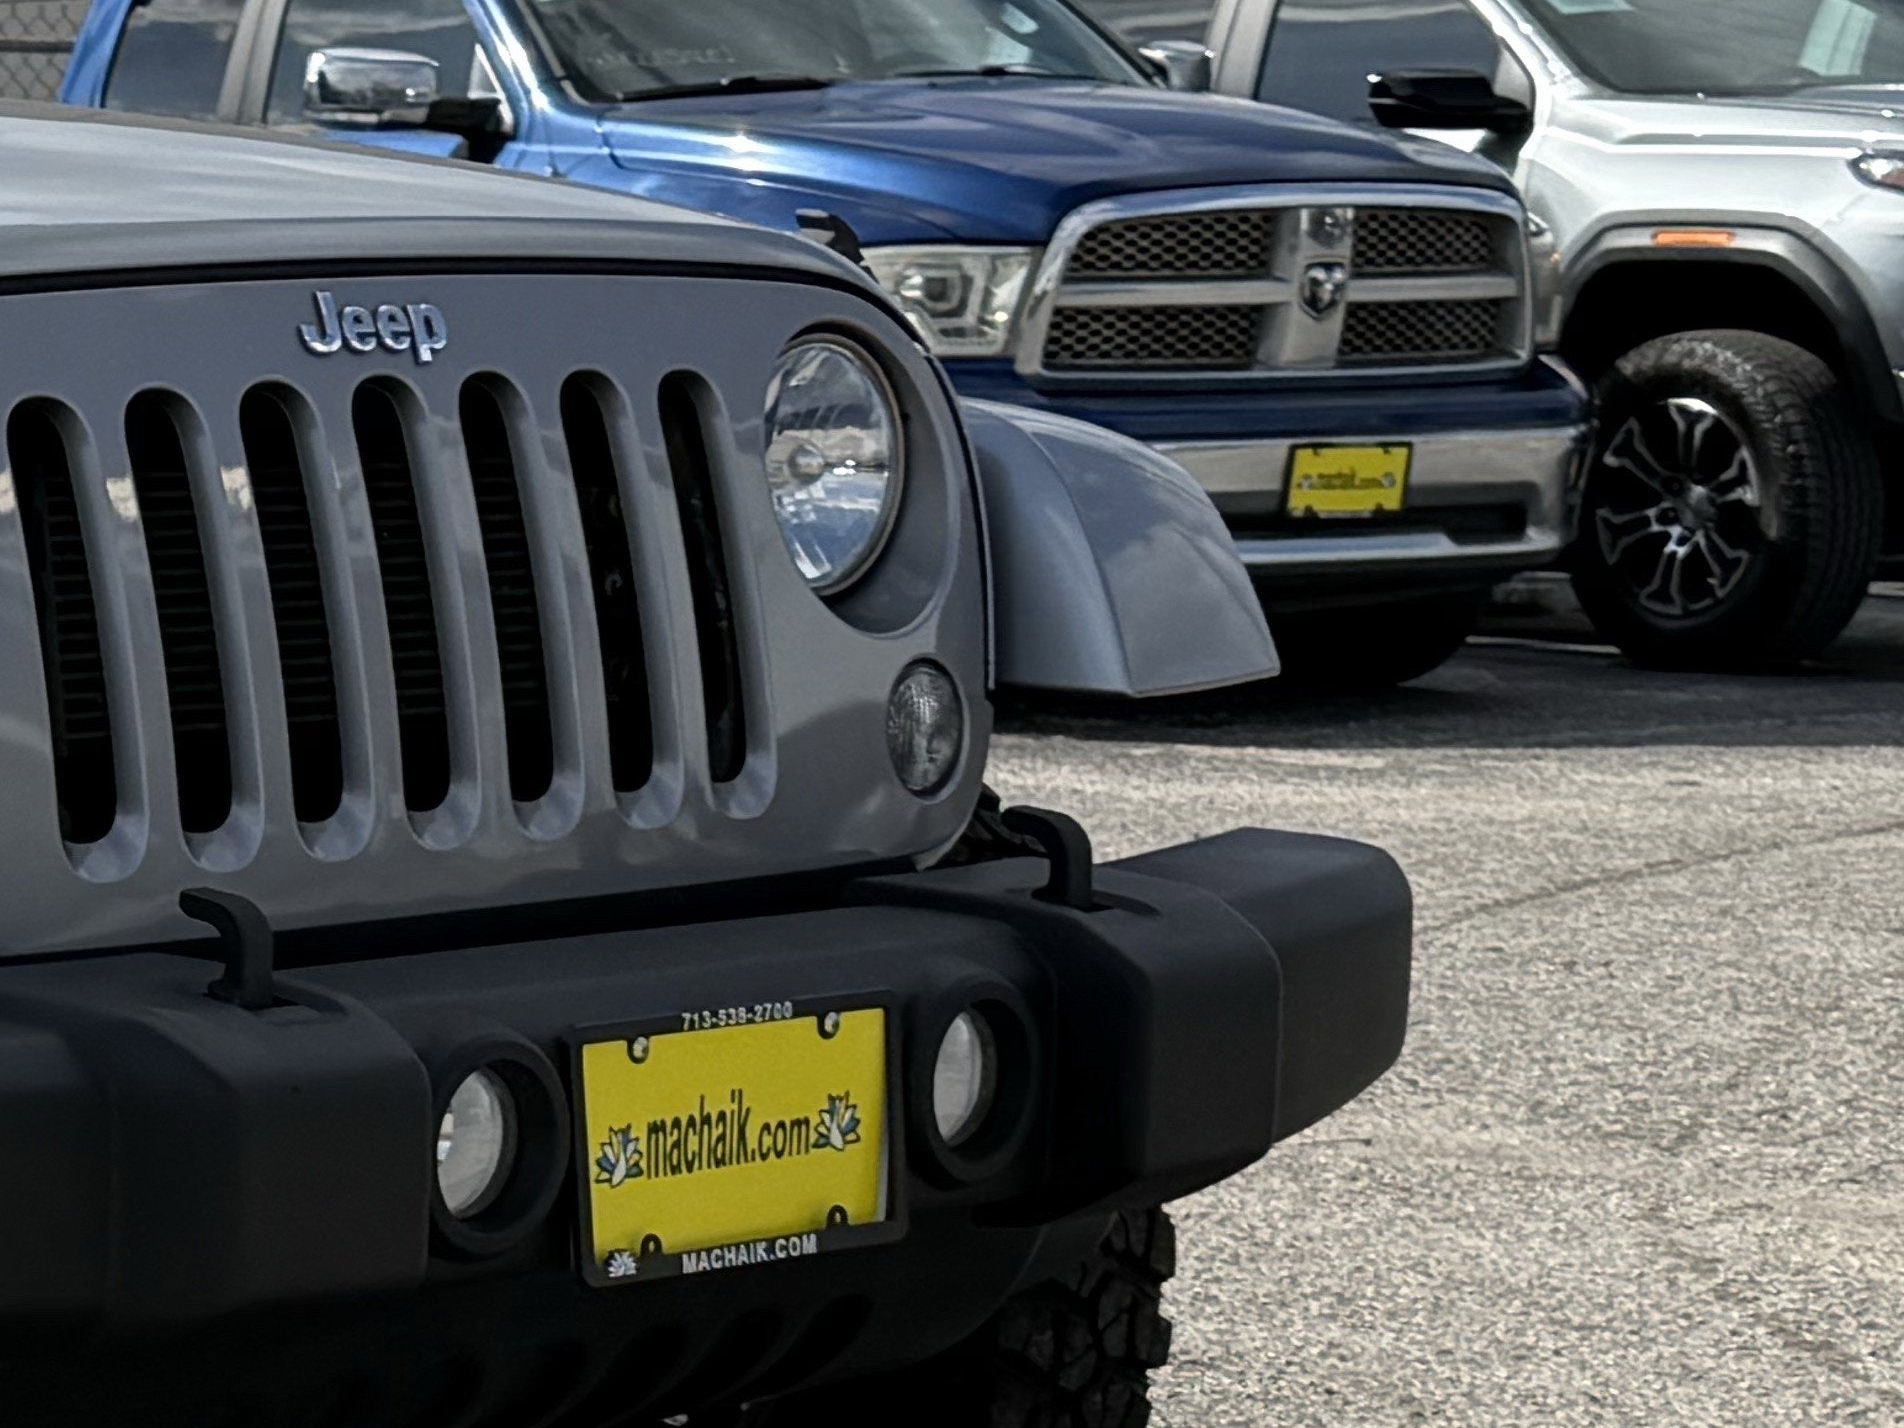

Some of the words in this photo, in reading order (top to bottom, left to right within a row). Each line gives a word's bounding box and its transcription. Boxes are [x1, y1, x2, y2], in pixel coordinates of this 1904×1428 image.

[297, 290, 449, 364] Jeep
[646, 1088, 811, 1180] machaik.com
[681, 1232, 819, 1274] MACHAIK.COM
